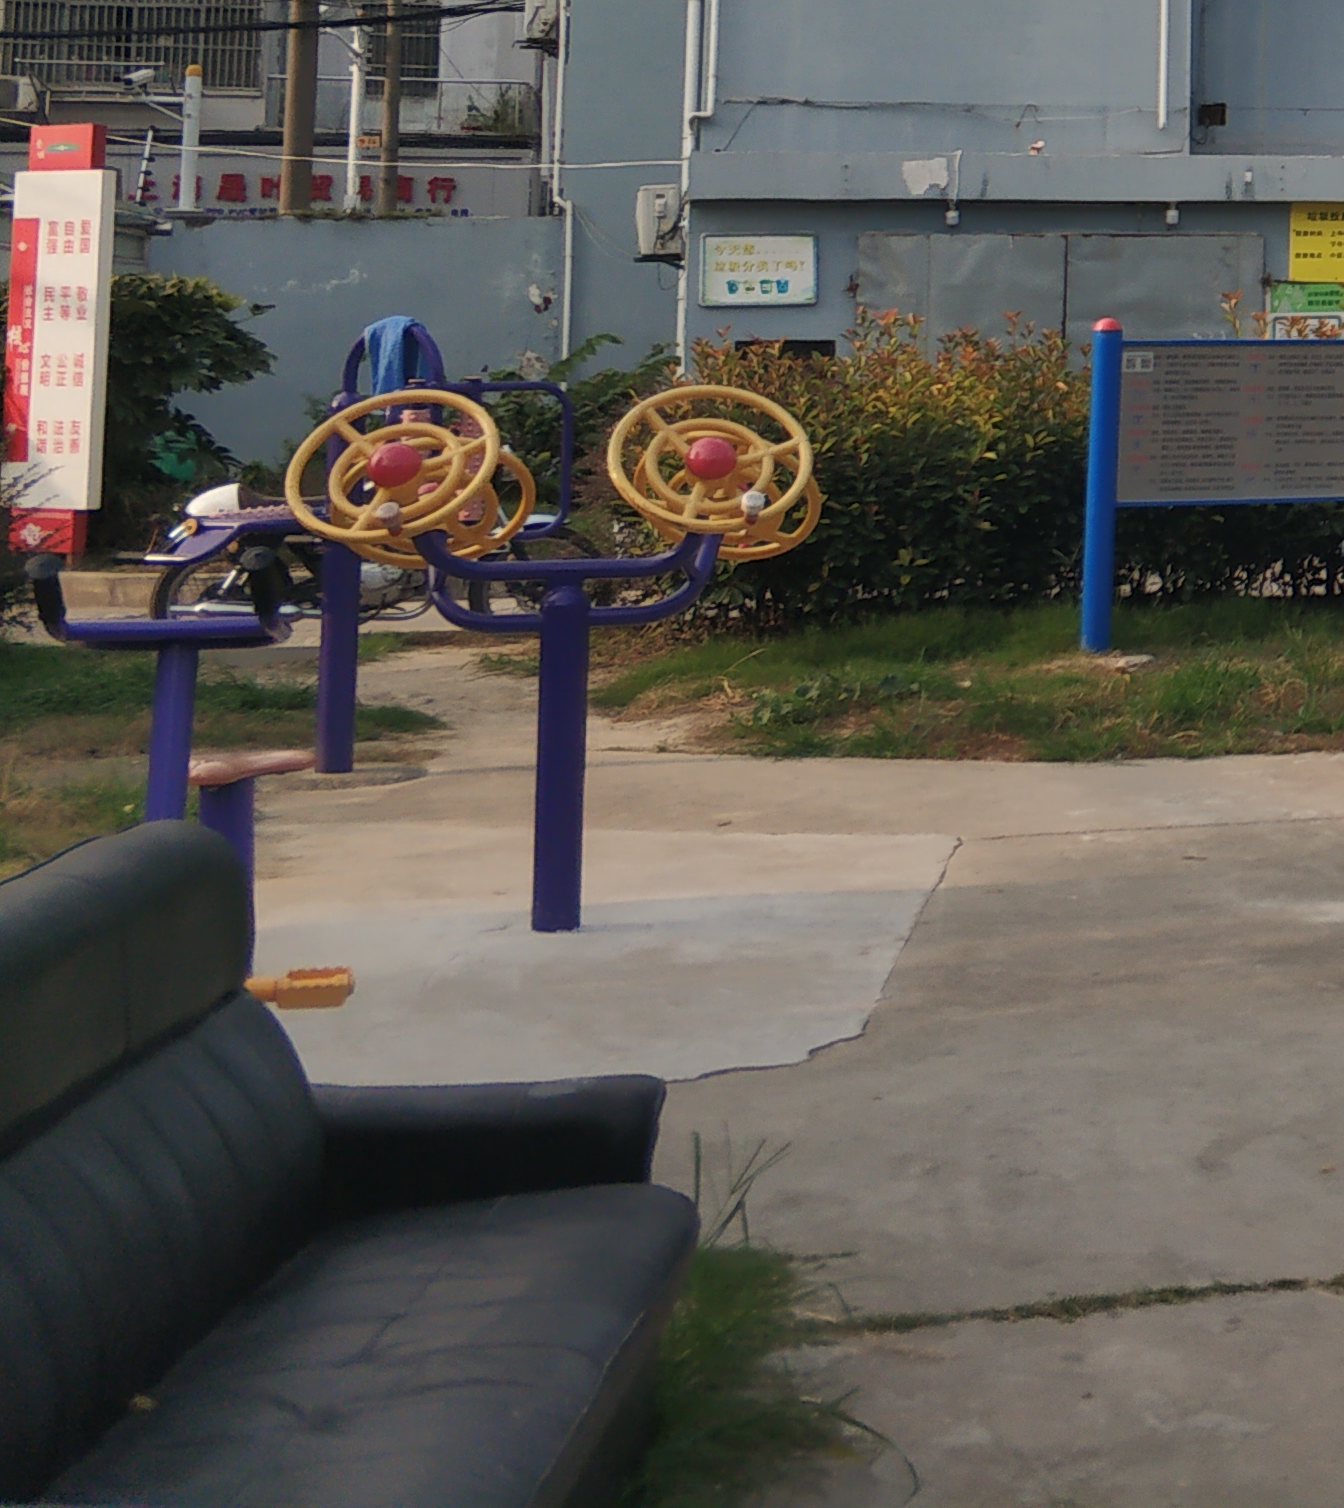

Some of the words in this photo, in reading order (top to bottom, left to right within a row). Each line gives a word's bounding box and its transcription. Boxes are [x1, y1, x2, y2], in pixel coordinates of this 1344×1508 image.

[63, 219, 75, 254] 自由
[80, 218, 92, 254] 爱国
[43, 286, 55, 321] 民主
[39, 353, 52, 387] 文明
